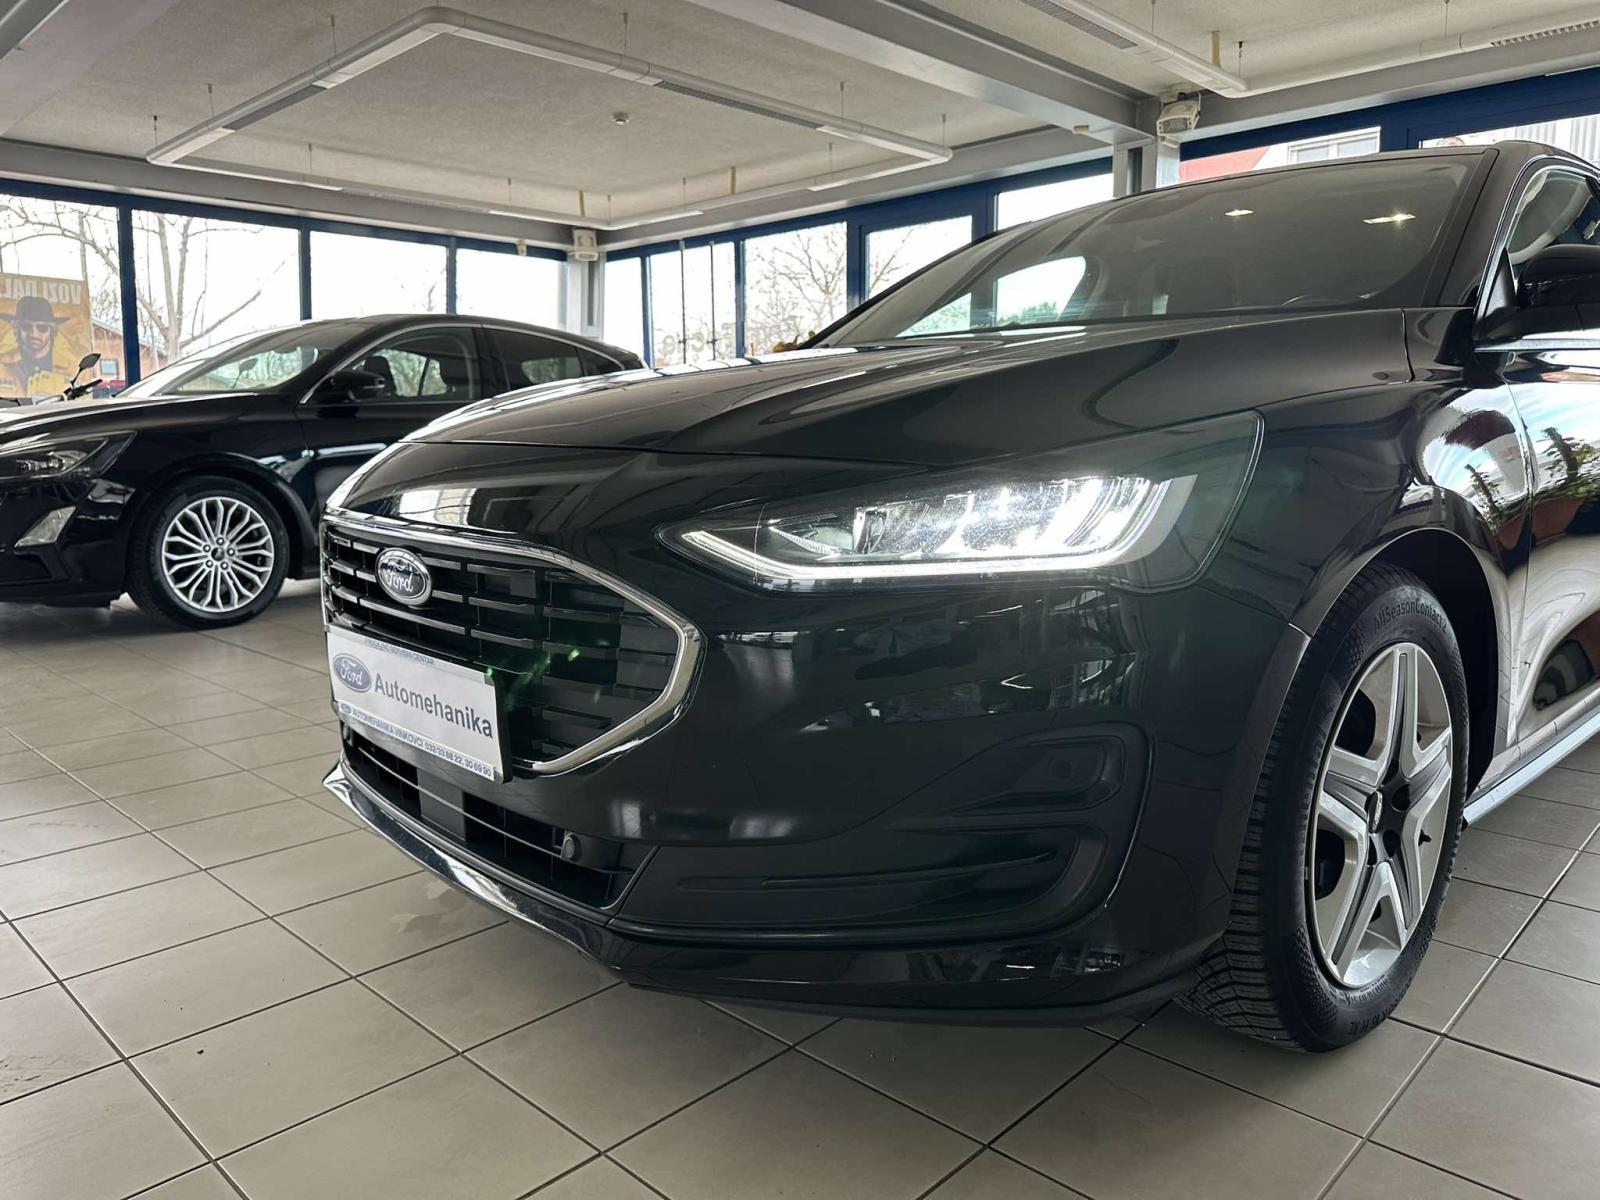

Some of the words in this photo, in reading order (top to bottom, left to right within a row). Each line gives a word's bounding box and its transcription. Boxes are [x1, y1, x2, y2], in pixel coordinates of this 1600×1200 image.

[1374, 598, 1442, 634] AllSeasonContact
[340, 657, 364, 687] Ford
[374, 673, 494, 740] Automehanika
